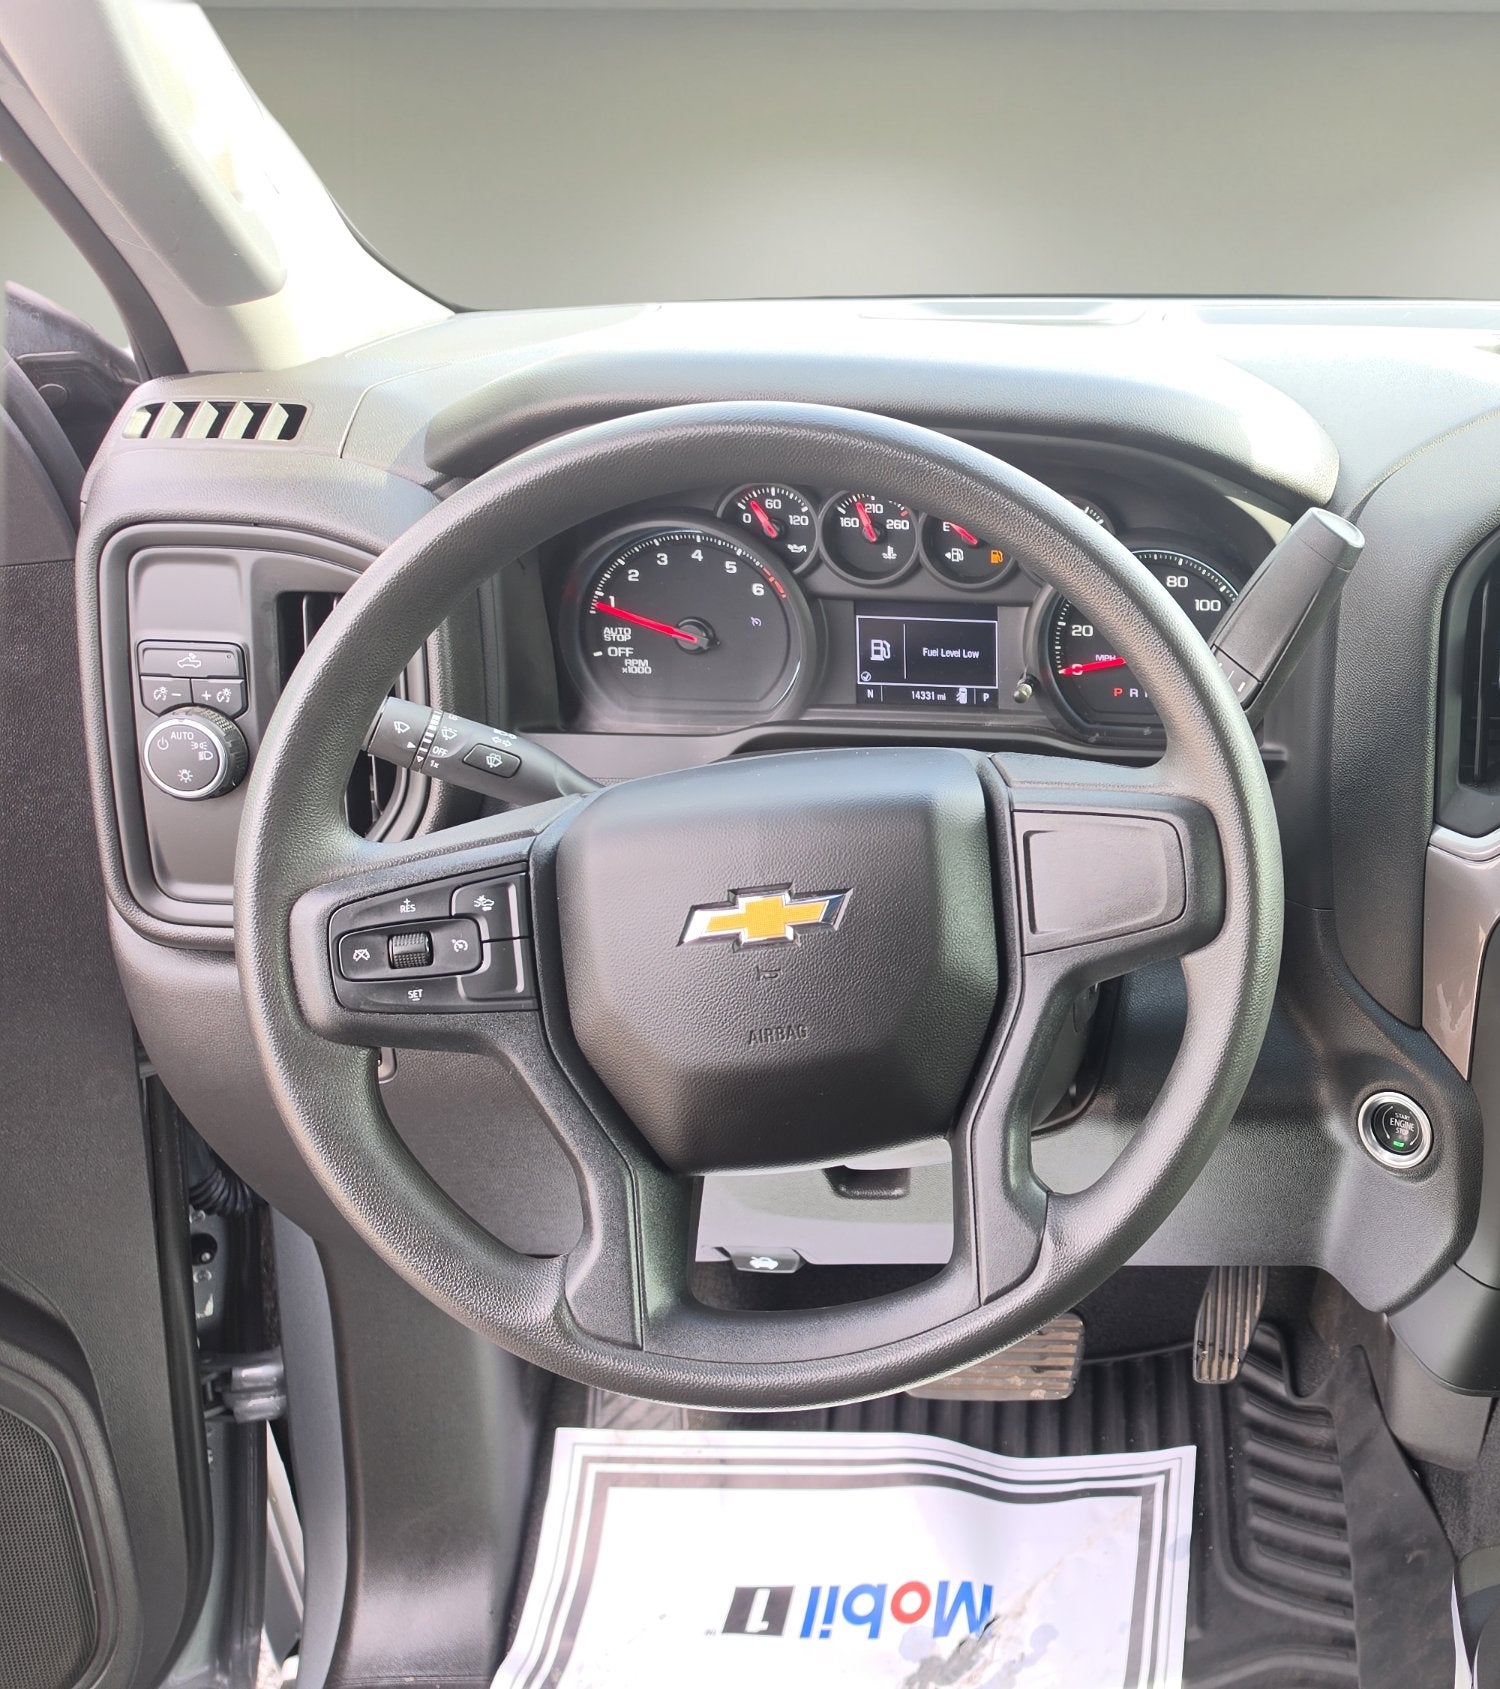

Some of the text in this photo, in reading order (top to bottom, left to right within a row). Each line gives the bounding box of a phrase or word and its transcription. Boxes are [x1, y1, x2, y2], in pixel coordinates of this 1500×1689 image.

[765, 499, 782, 510] 60
[865, 503, 884, 514] 210
[742, 513, 752, 524] 0
[789, 515, 809, 526] 120
[840, 517, 860, 528] 160
[886, 519, 910, 530] 260
[656, 553, 668, 566] 3
[691, 549, 704, 562] 4
[725, 561, 737, 574] 5
[627, 569, 640, 582] 2
[1166, 576, 1189, 588] 80
[752, 583, 765, 596] 6
[609, 595, 615, 608] 1
[1195, 599, 1222, 612] 100
[1071, 625, 1094, 637] 20
[607, 647, 634, 657] OFF
[922, 647, 980, 659] Fuel Level Low
[1095, 654, 1117, 662] MPH
[624, 659, 649, 667] RPM
[866, 689, 874, 698] N
[911, 690, 935, 701] 14331
[982, 692, 990, 702] P
[1113, 688, 1139, 698] P R
[170, 731, 194, 740] AUTO
[432, 745, 449, 757] OFF
[400, 903, 416, 913] RES
[408, 989, 423, 999] SET
[749, 1026, 808, 1044] AIRBAG
[1390, 1117, 1415, 1132] ENGINE
[799, 1580, 994, 1640] Mobil
